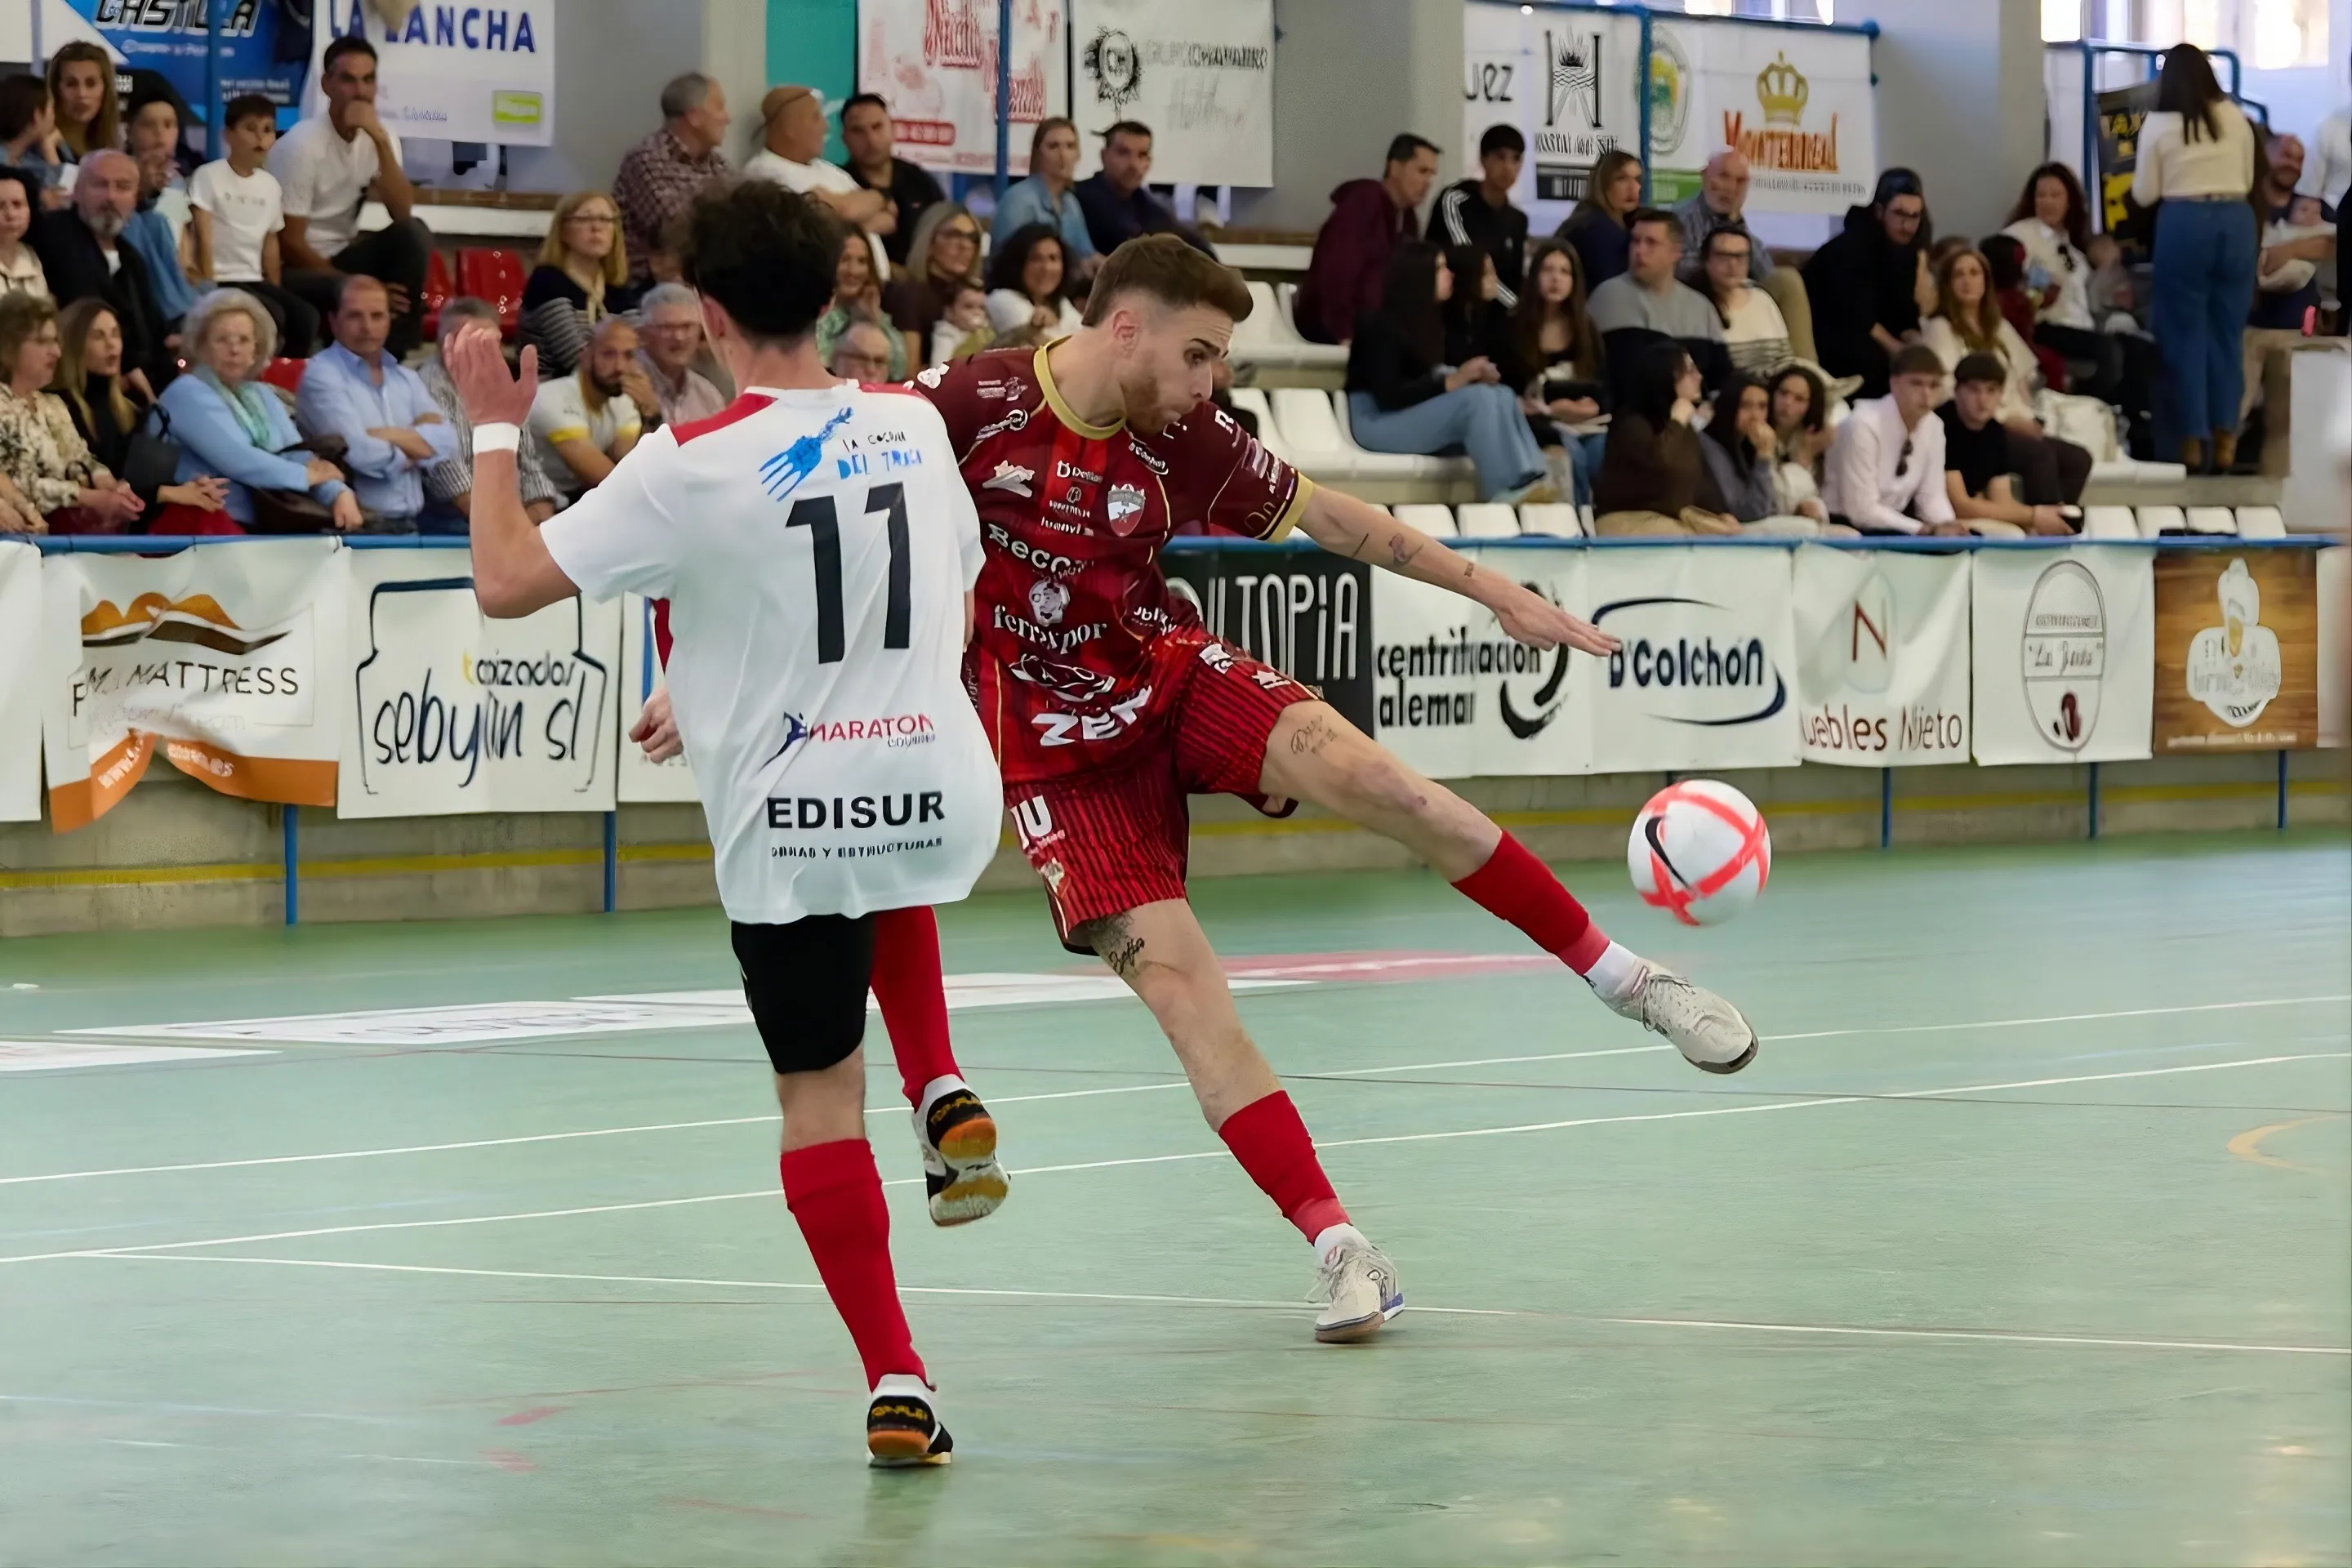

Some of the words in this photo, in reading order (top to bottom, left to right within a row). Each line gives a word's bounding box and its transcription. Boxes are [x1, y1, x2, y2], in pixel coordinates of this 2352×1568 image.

[385, 7, 535, 53] ANCHA
[786, 482, 911, 664] 11
[1851, 599, 1888, 663] N
[809, 713, 933, 742] MARATON
[767, 791, 946, 830] EDISUR
